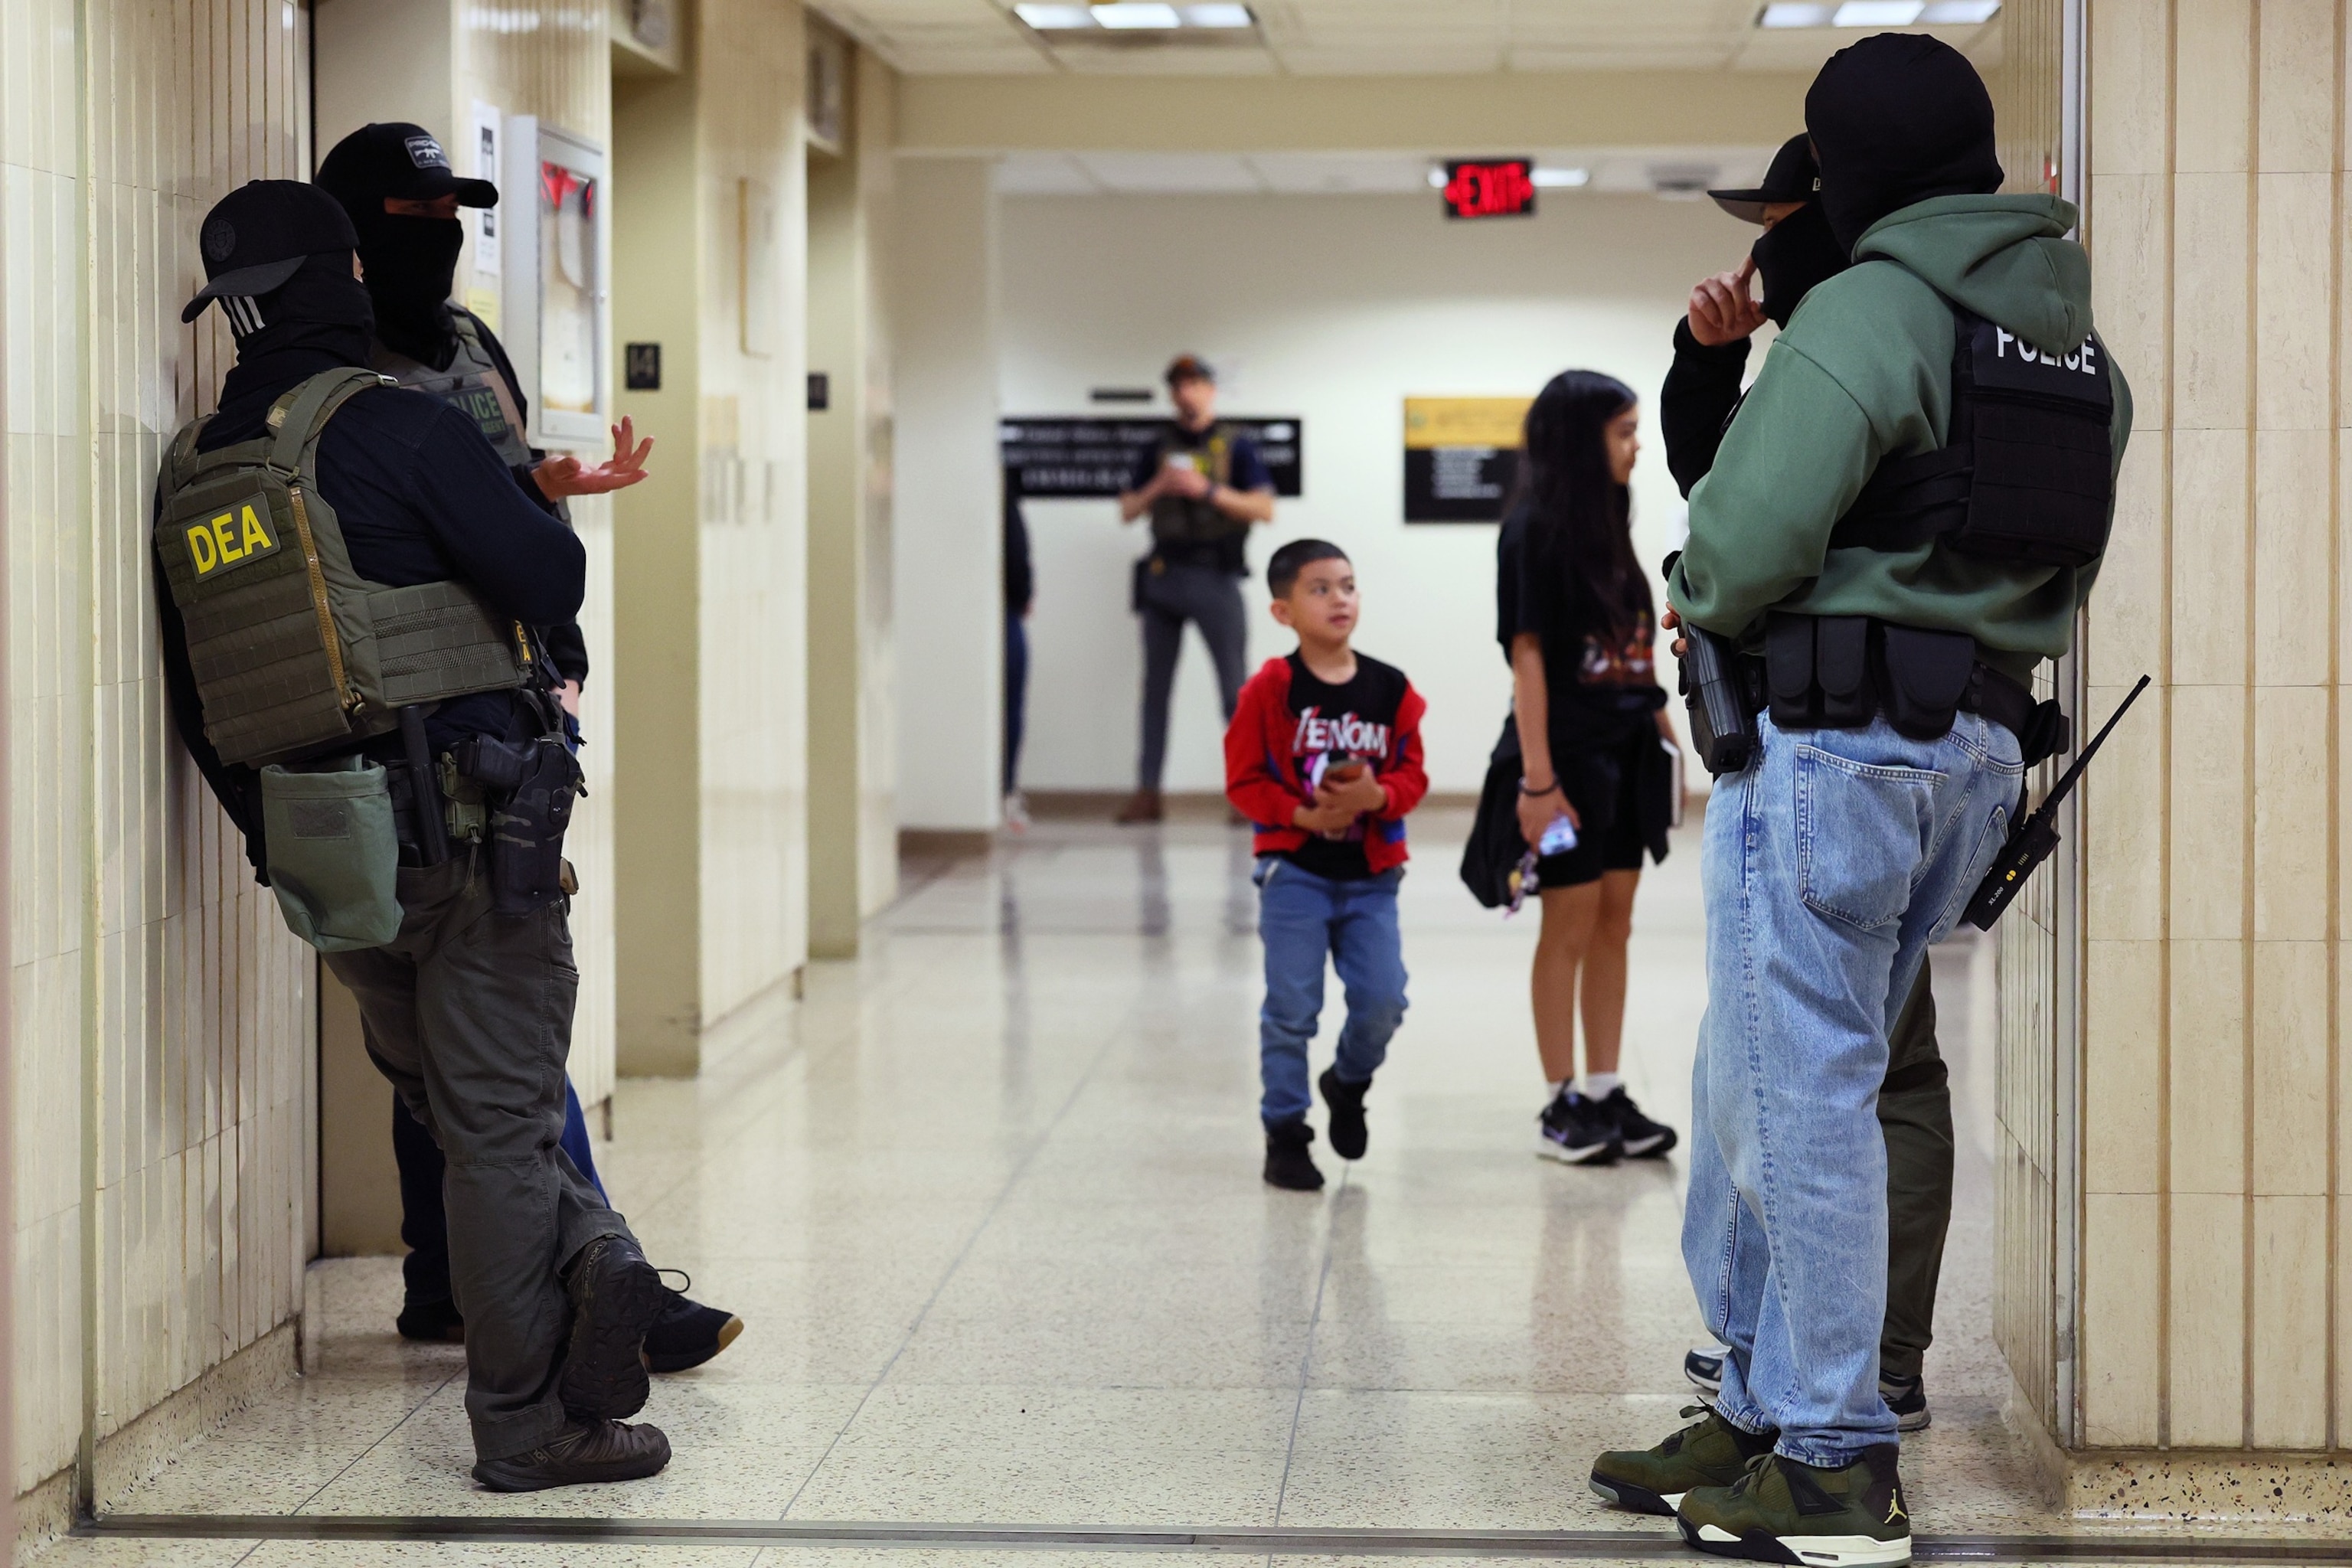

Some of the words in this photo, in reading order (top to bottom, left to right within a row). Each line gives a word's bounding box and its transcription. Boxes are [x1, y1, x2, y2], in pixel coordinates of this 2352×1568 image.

[447, 391, 501, 420] LICE
[187, 505, 272, 574] DEA
[514, 619, 531, 662] EA
